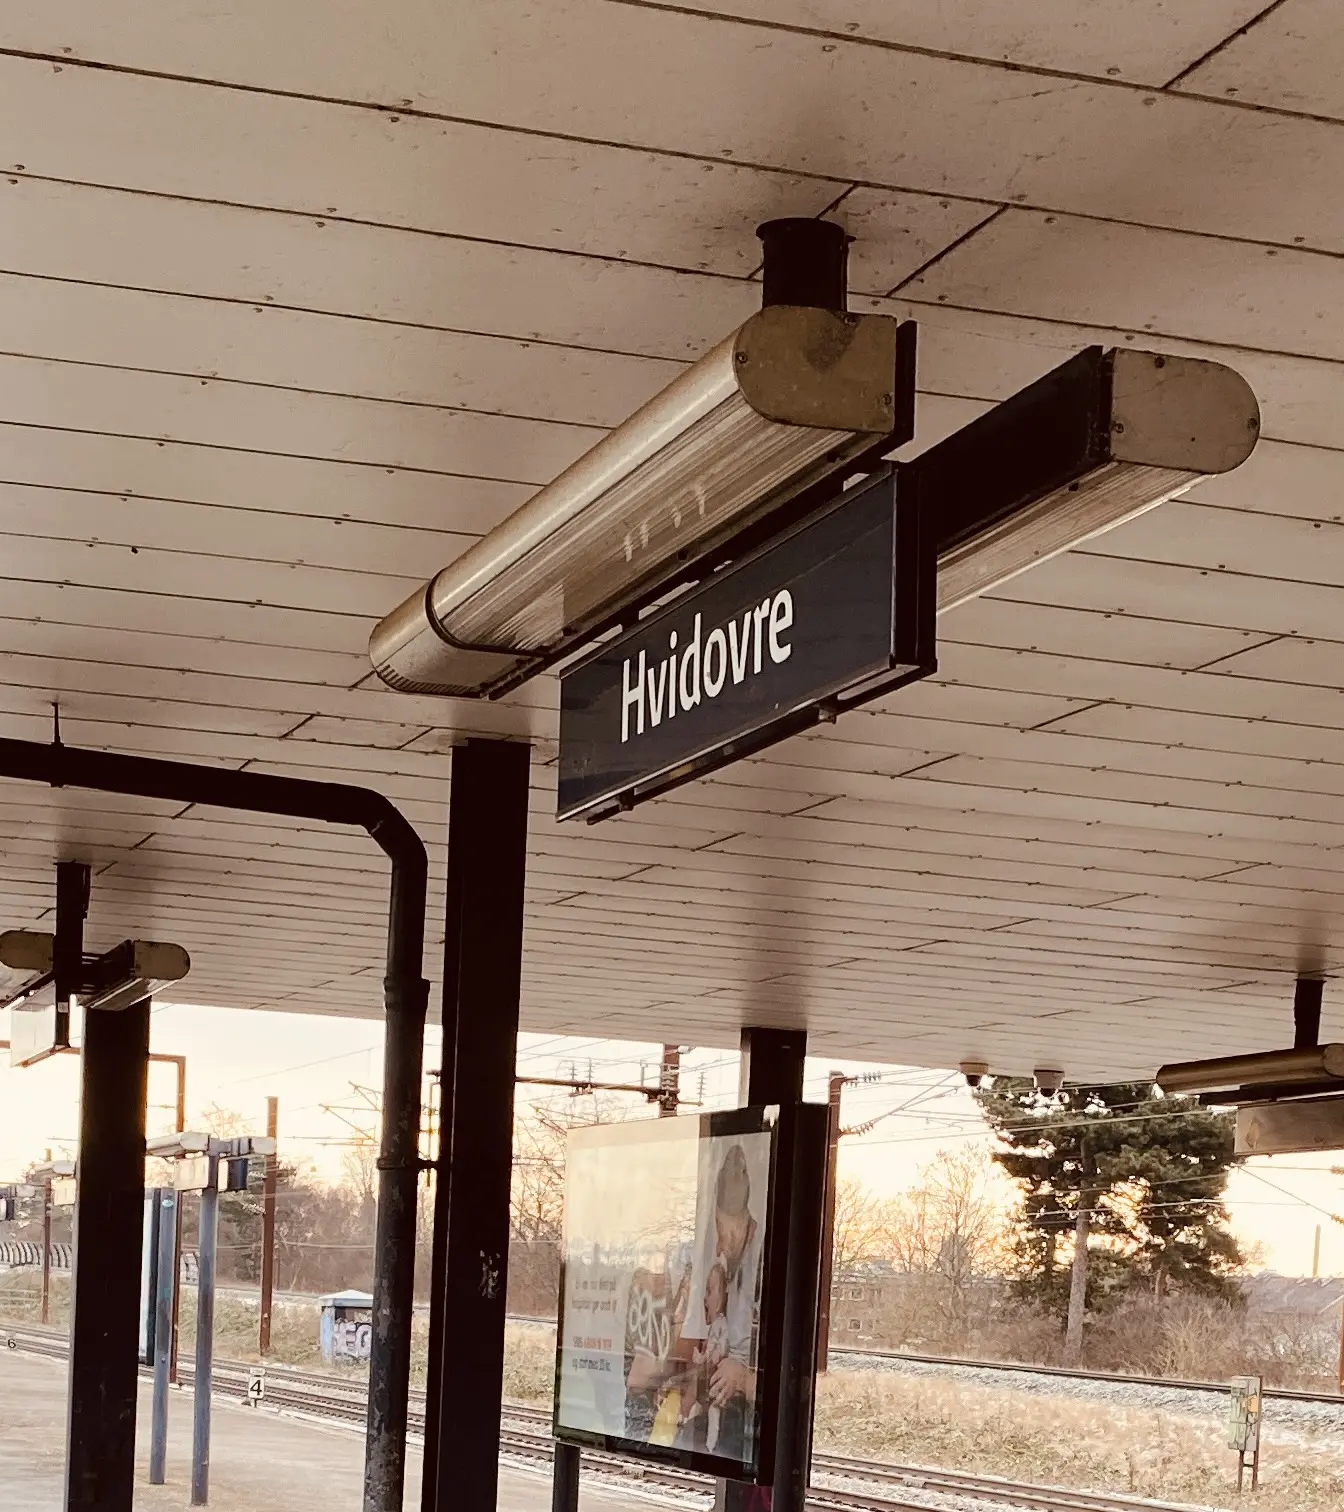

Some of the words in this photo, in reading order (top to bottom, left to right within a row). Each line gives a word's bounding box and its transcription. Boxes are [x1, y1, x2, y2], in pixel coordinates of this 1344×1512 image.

[621, 589, 794, 743] Hvidovre
[7, 1338, 17, 1349] 6
[249, 1379, 263, 1396] 4
